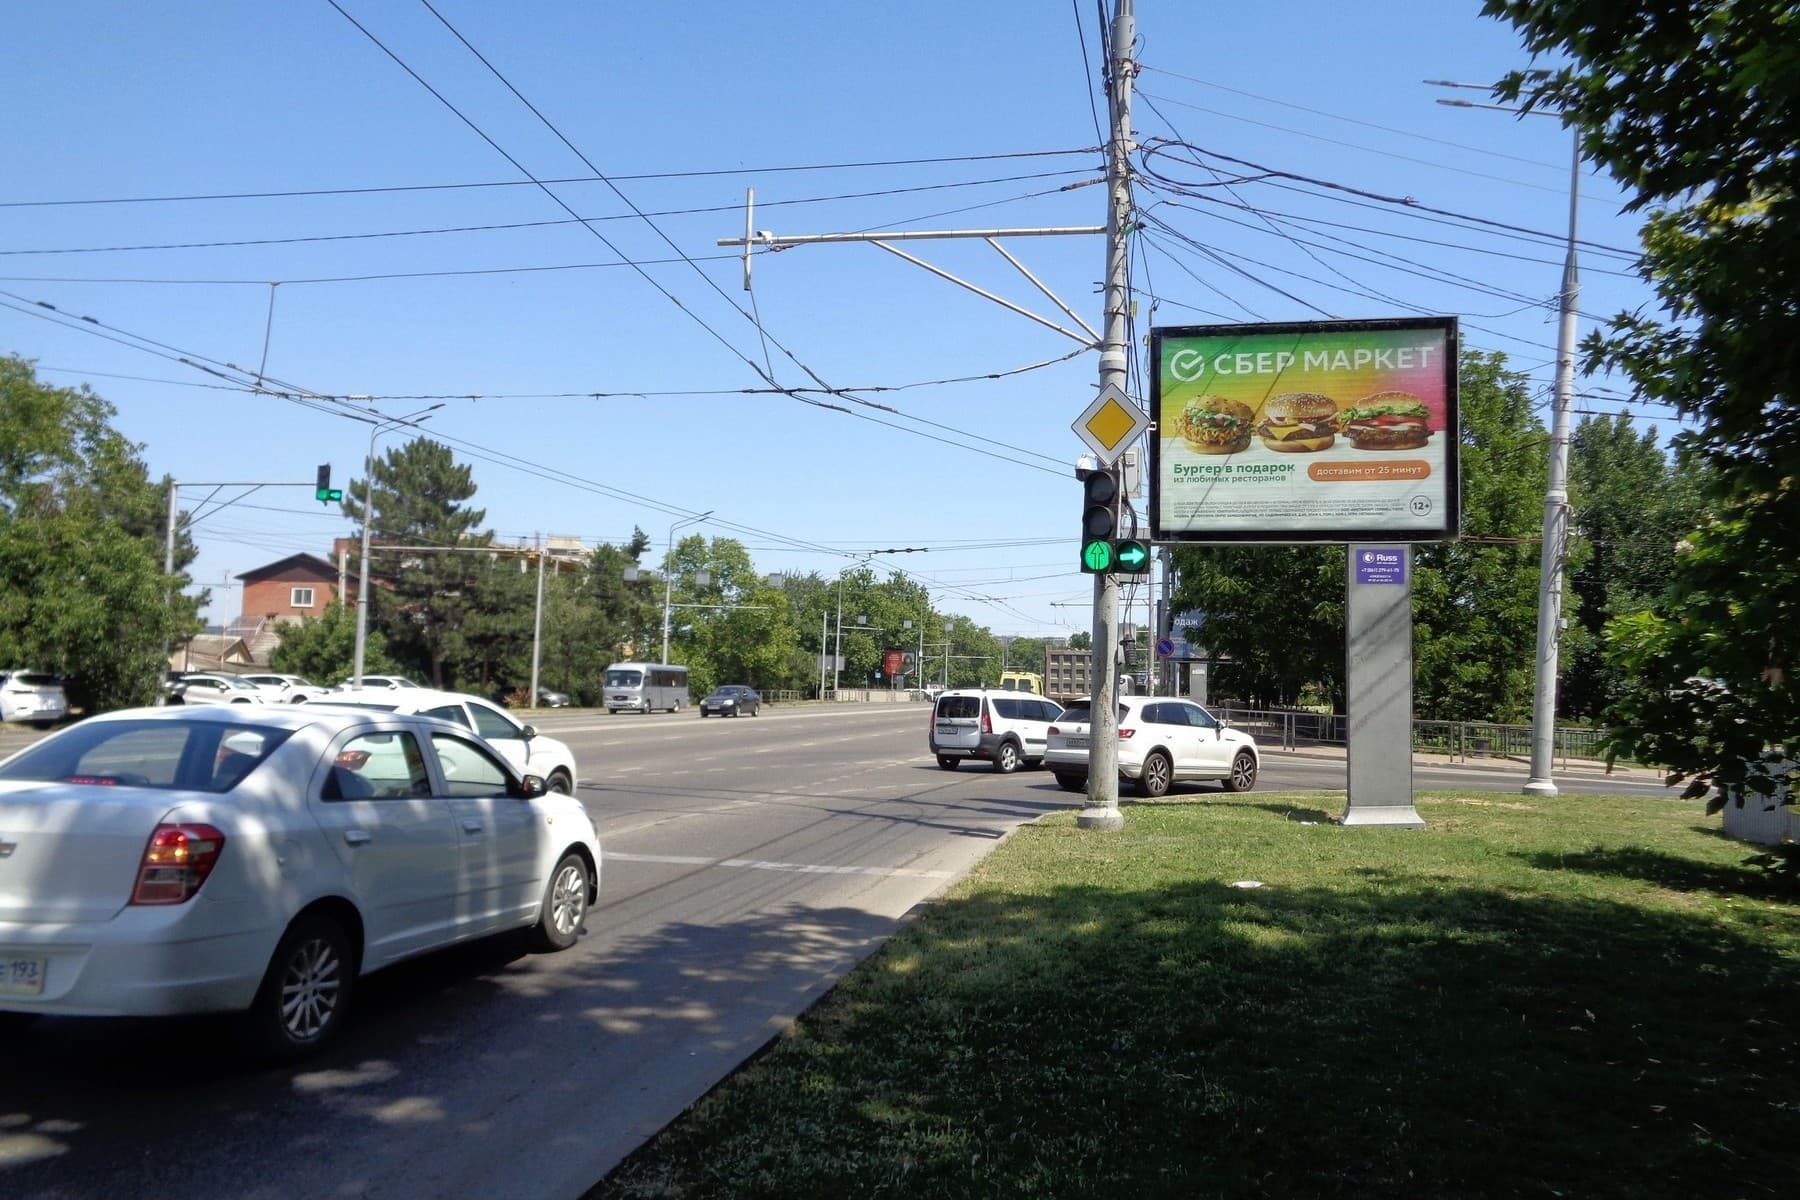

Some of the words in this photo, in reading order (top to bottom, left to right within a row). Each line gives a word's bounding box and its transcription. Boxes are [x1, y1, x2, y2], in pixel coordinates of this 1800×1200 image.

[1214, 351, 1295, 375] СБЕР
[1304, 346, 1435, 372] МАРКЕТ
[1173, 463, 1222, 476] Бургер
[1225, 465, 1233, 473] в
[1236, 463, 1295, 475] подарок
[1317, 468, 1362, 476] доставим
[1364, 467, 1376, 475] от
[1378, 466, 1390, 474] 25
[1392, 466, 1422, 476] минут
[1186, 475, 1230, 483] любимых
[1231, 475, 1287, 484] ресторанов
[1413, 502, 1429, 510] 12+
[1376, 553, 1398, 562] Russ
[1173, 617, 1199, 626] одаж
[10, 959, 39, 978] 193
